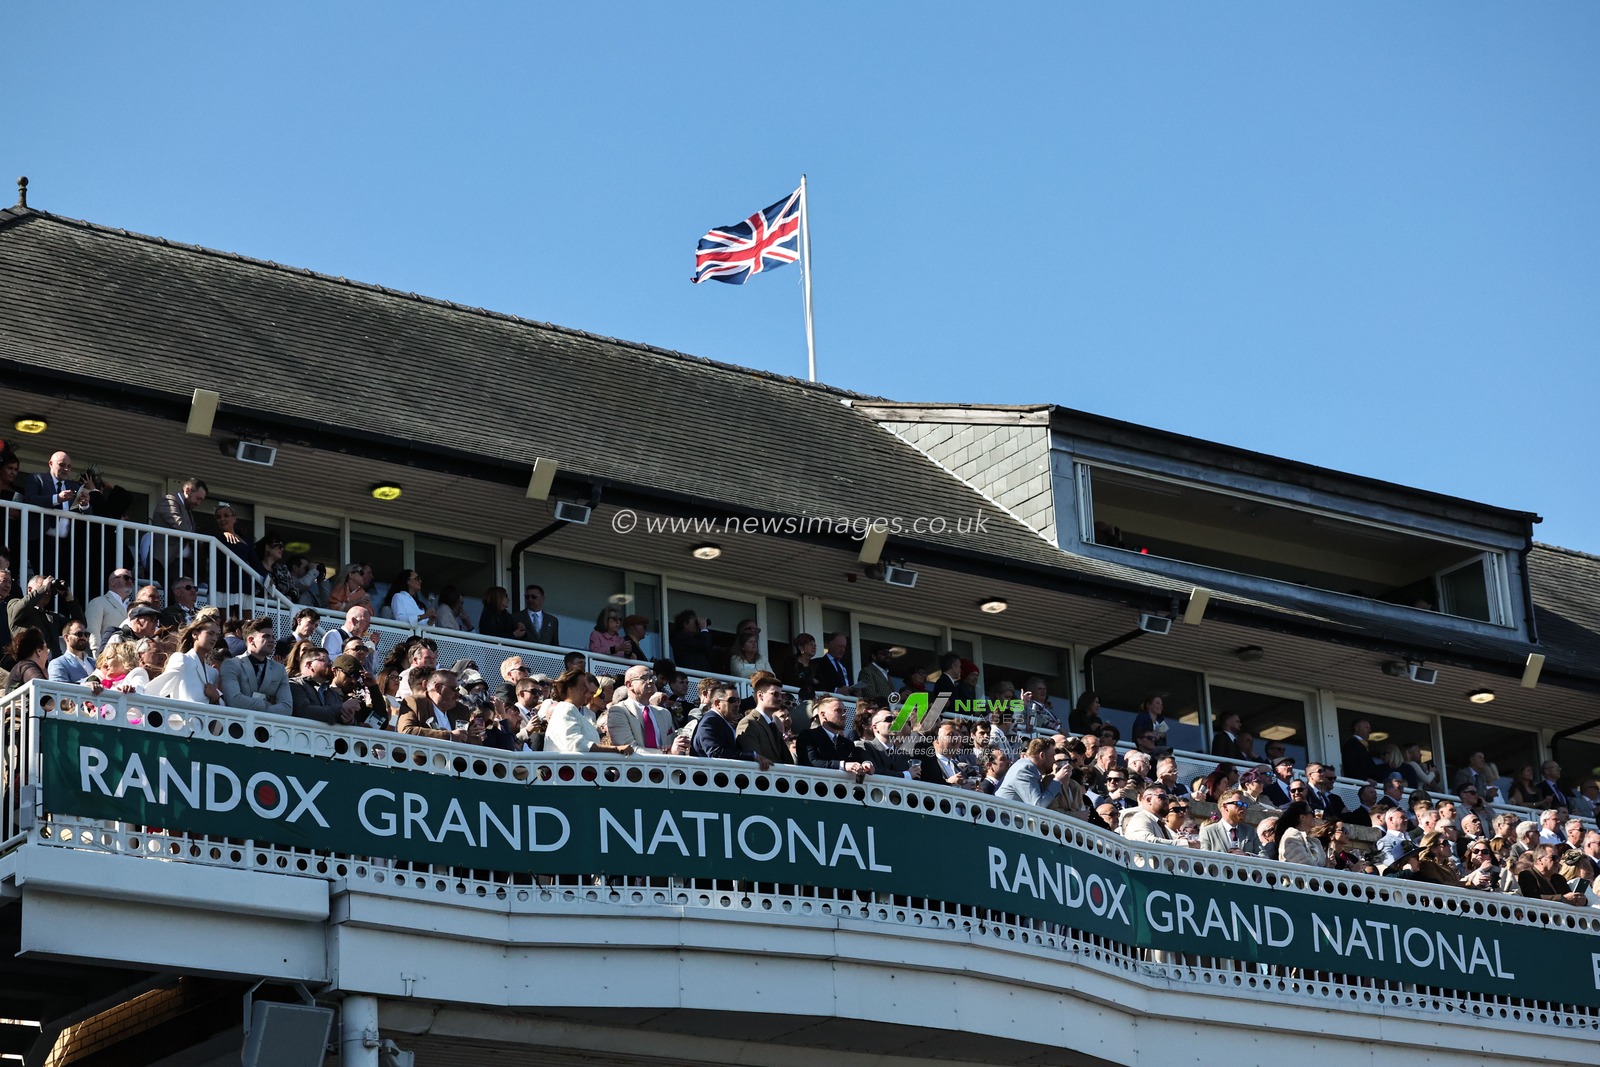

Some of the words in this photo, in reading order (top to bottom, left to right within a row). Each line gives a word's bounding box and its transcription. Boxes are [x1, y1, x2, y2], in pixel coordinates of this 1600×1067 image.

[80, 747, 330, 828] RANDOX
[358, 788, 571, 852] GRAND
[599, 808, 892, 873] NATIONAL
[987, 845, 1131, 926] RANDOX
[1145, 890, 1294, 948] GRAND
[1312, 914, 1515, 980] NATIONAL
